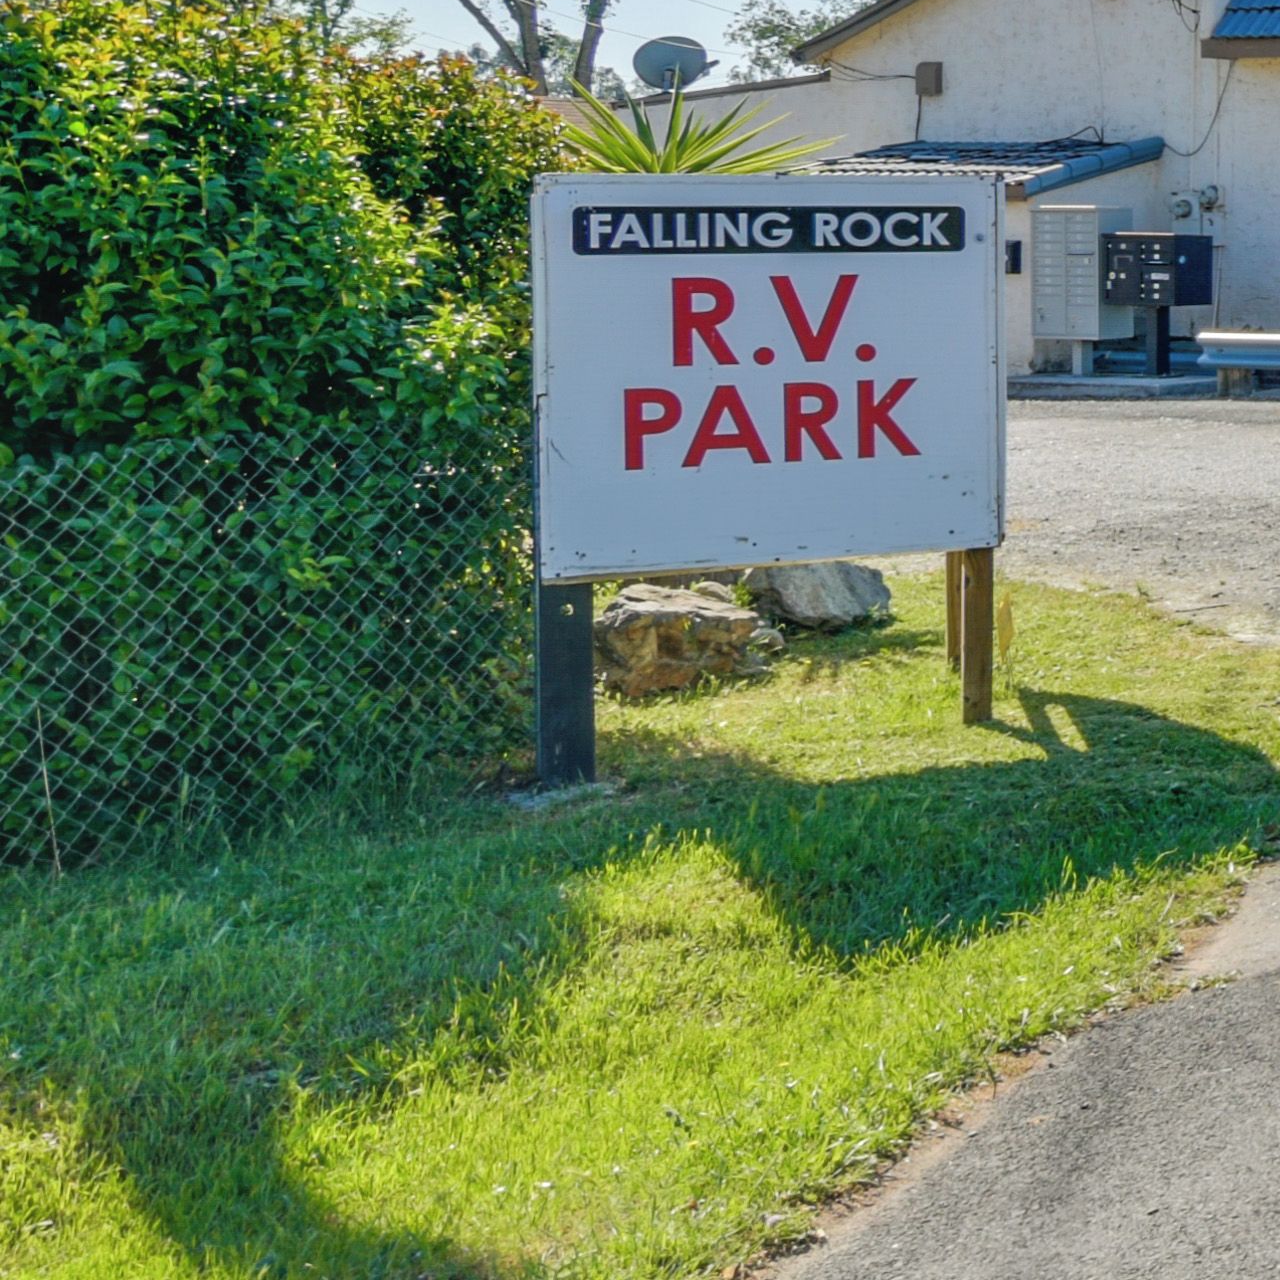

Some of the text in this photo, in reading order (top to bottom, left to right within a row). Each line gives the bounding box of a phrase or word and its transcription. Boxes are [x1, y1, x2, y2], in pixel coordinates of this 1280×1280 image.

[589, 211, 951, 248] FALLING ROCK
[671, 274, 877, 367] R.V.
[623, 377, 922, 471] PARK
